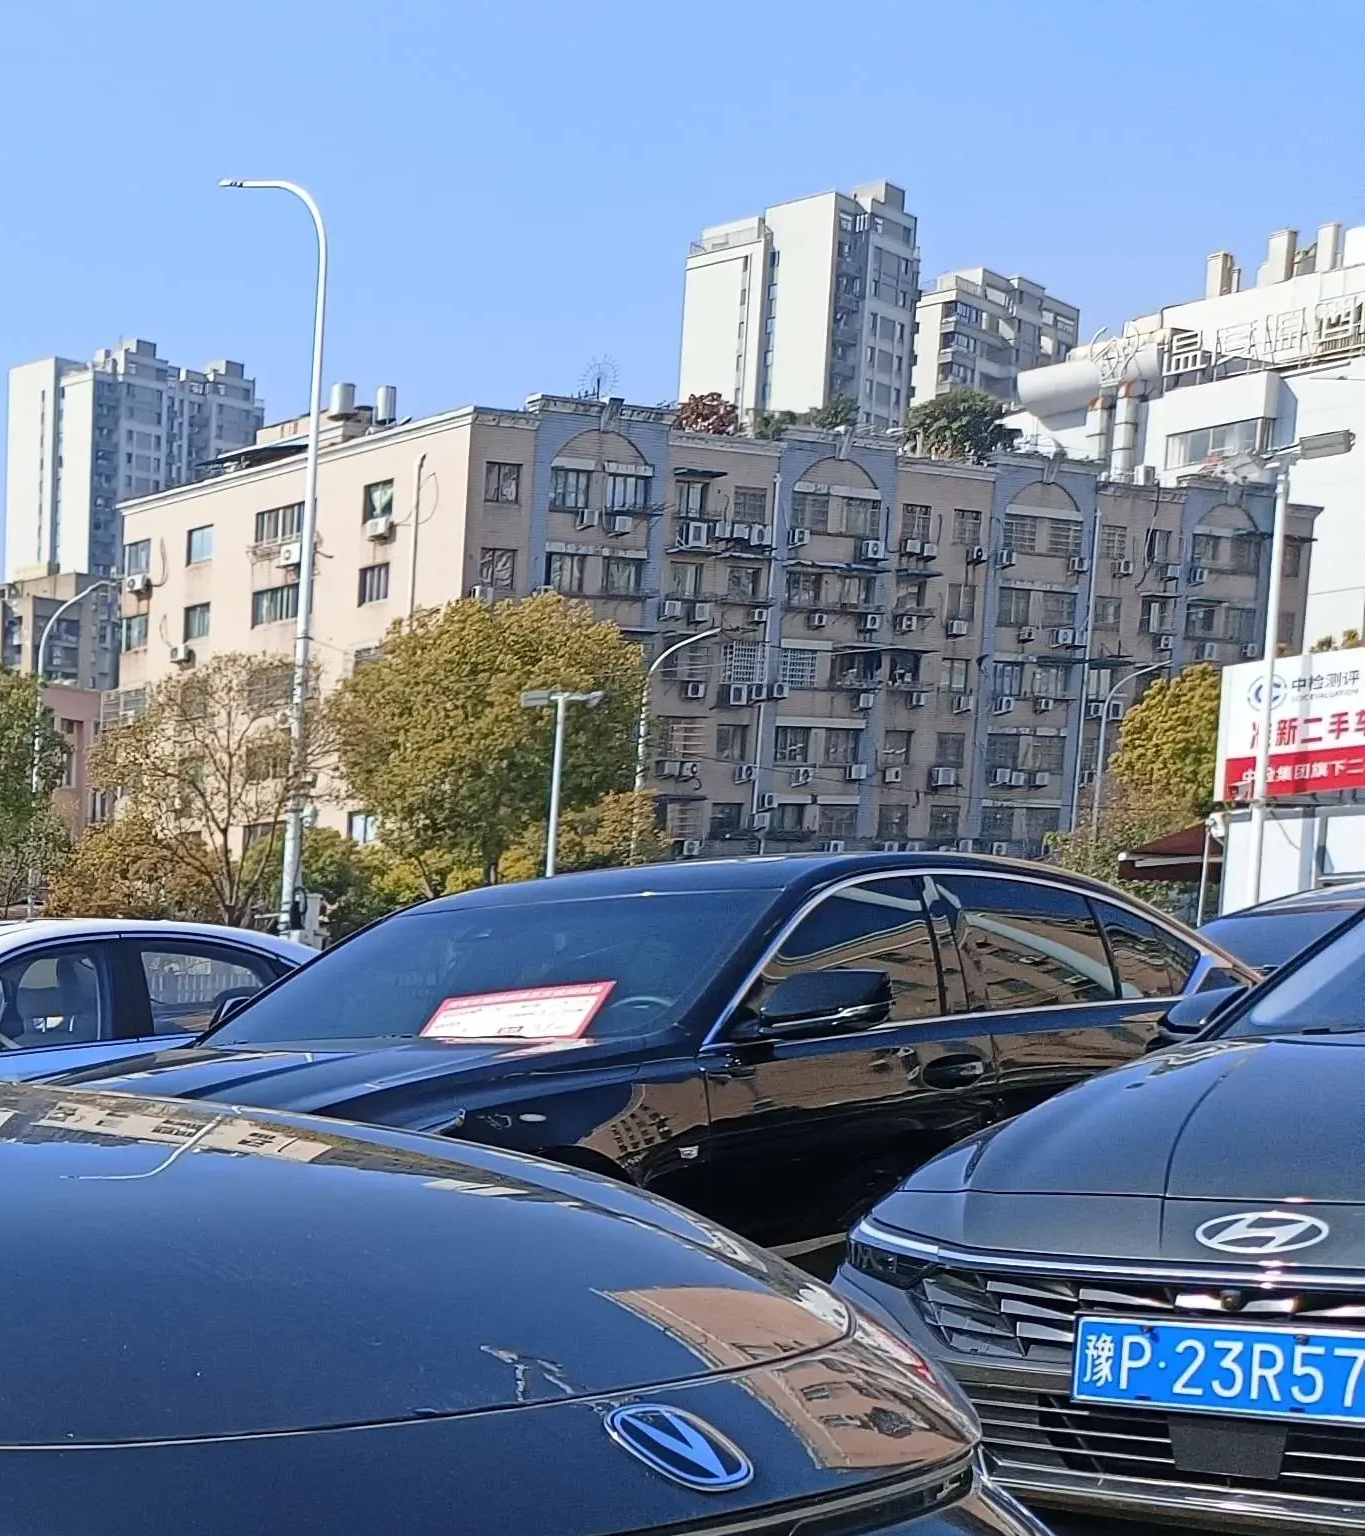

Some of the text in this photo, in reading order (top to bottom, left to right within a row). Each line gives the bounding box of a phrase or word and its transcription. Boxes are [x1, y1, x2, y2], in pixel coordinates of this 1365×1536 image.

[1291, 669, 1360, 692] 中检测评
[1083, 1332, 1365, 1408] 豫P·23R57
